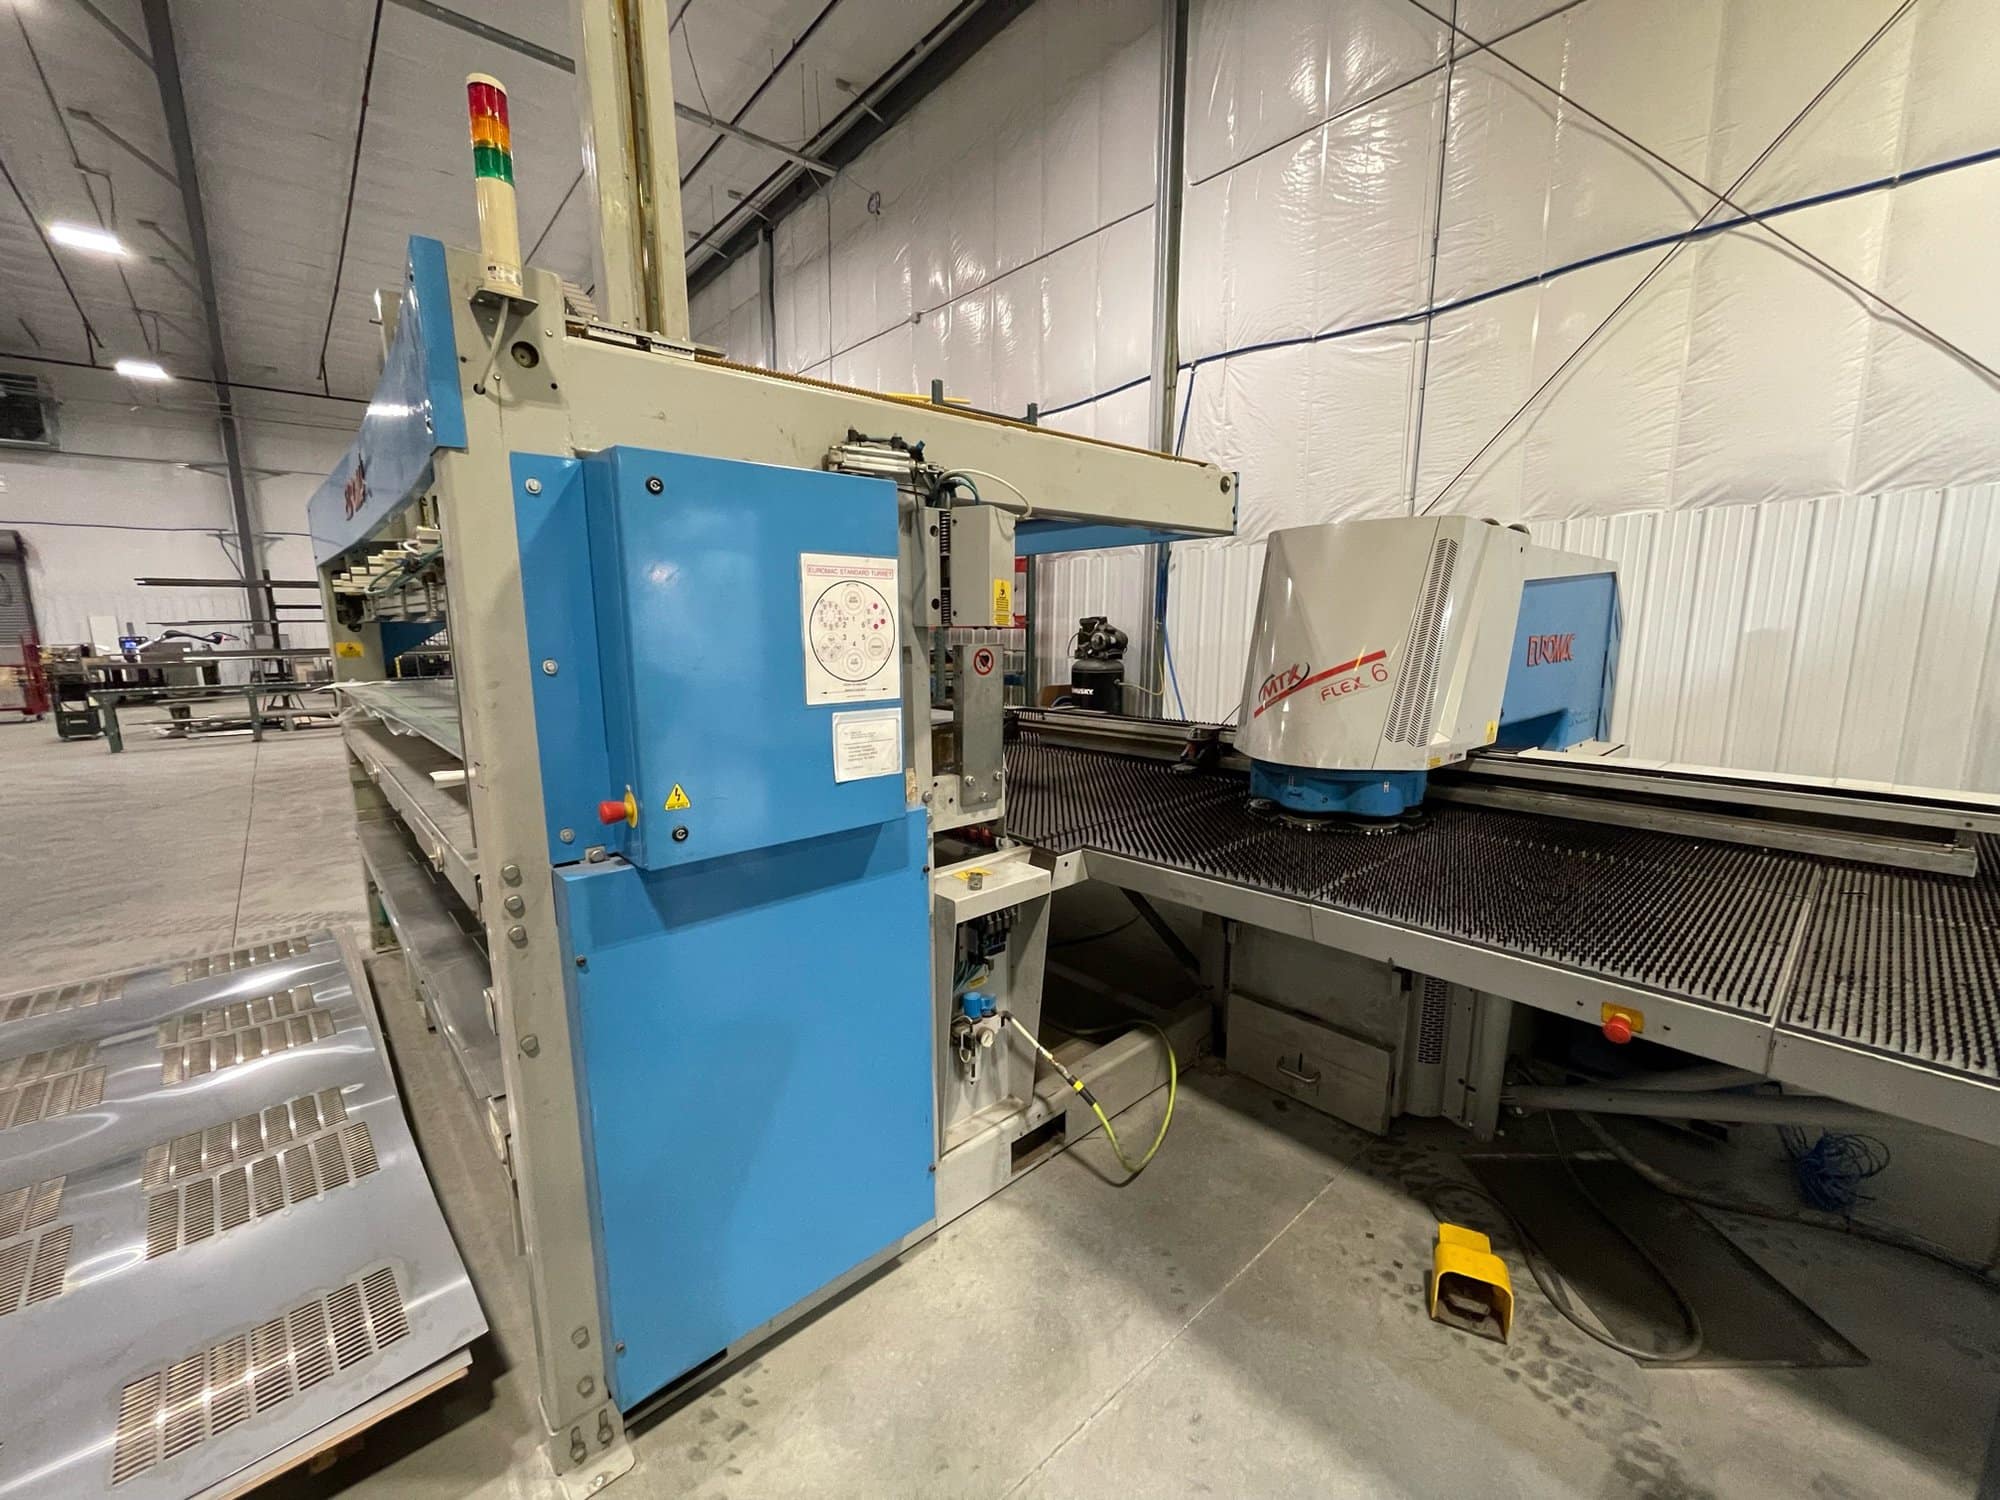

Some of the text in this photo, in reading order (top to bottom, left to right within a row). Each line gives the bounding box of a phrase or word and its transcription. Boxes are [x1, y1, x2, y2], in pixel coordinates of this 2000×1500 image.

[840, 568, 870, 576] STANDARD
[1262, 664, 1303, 700] MTX
[1321, 663, 1389, 701] FLEX 6
